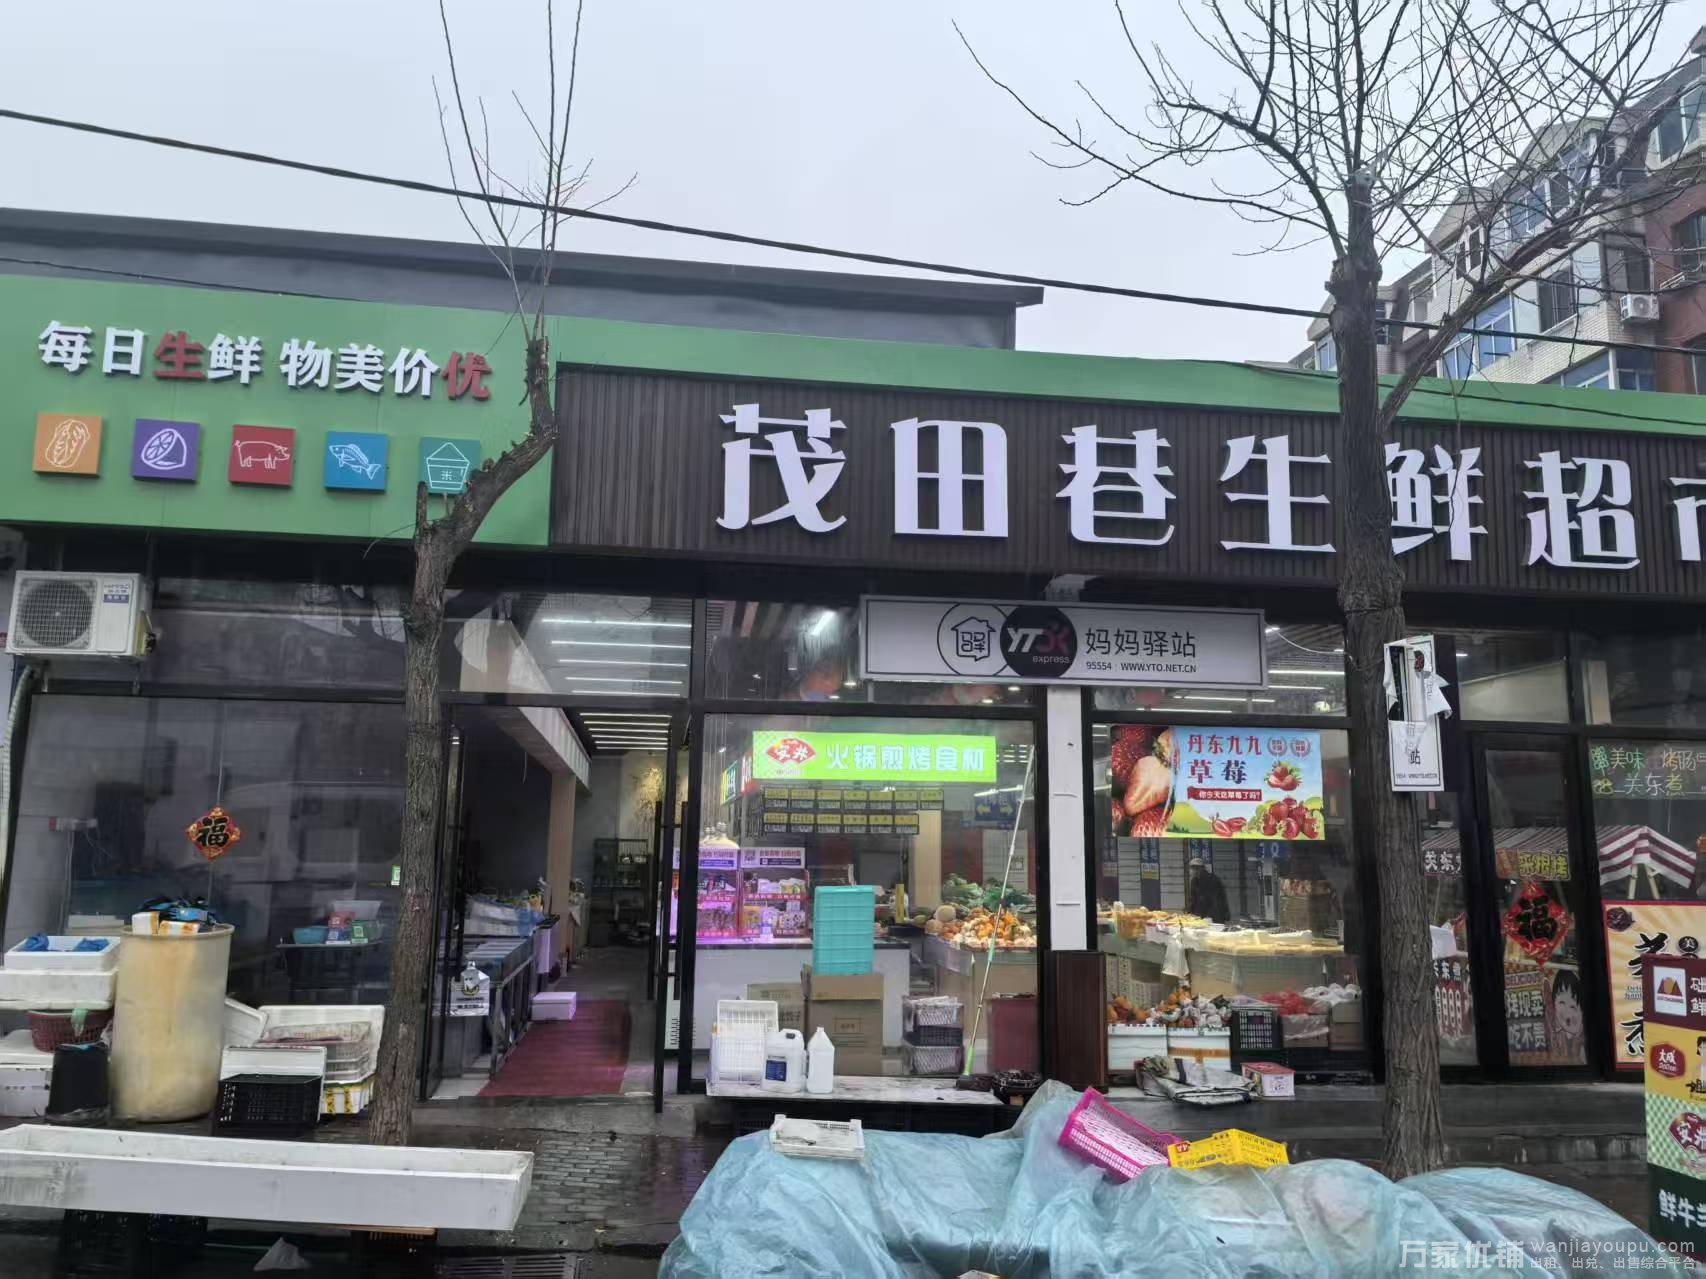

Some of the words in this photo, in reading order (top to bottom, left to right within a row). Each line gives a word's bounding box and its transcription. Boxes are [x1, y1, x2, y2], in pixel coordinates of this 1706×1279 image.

[38, 320, 262, 385] 每日生鲜
[280, 337, 492, 400] 物美价优
[1085, 627, 1197, 658] 妈妈驿站
[1032, 655, 1070, 664] express
[1086, 661, 1112, 671] 95554
[1120, 662, 1197, 673] WWW.YTO.NET.CN
[826, 743, 985, 772] 火锅煎烤食材
[1187, 734, 1262, 756] 丹东九九
[1187, 759, 1247, 785] 草莓
[1610, 747, 1645, 771] 美味
[198, 816, 230, 847] 福
[1513, 894, 1558, 942] 福
